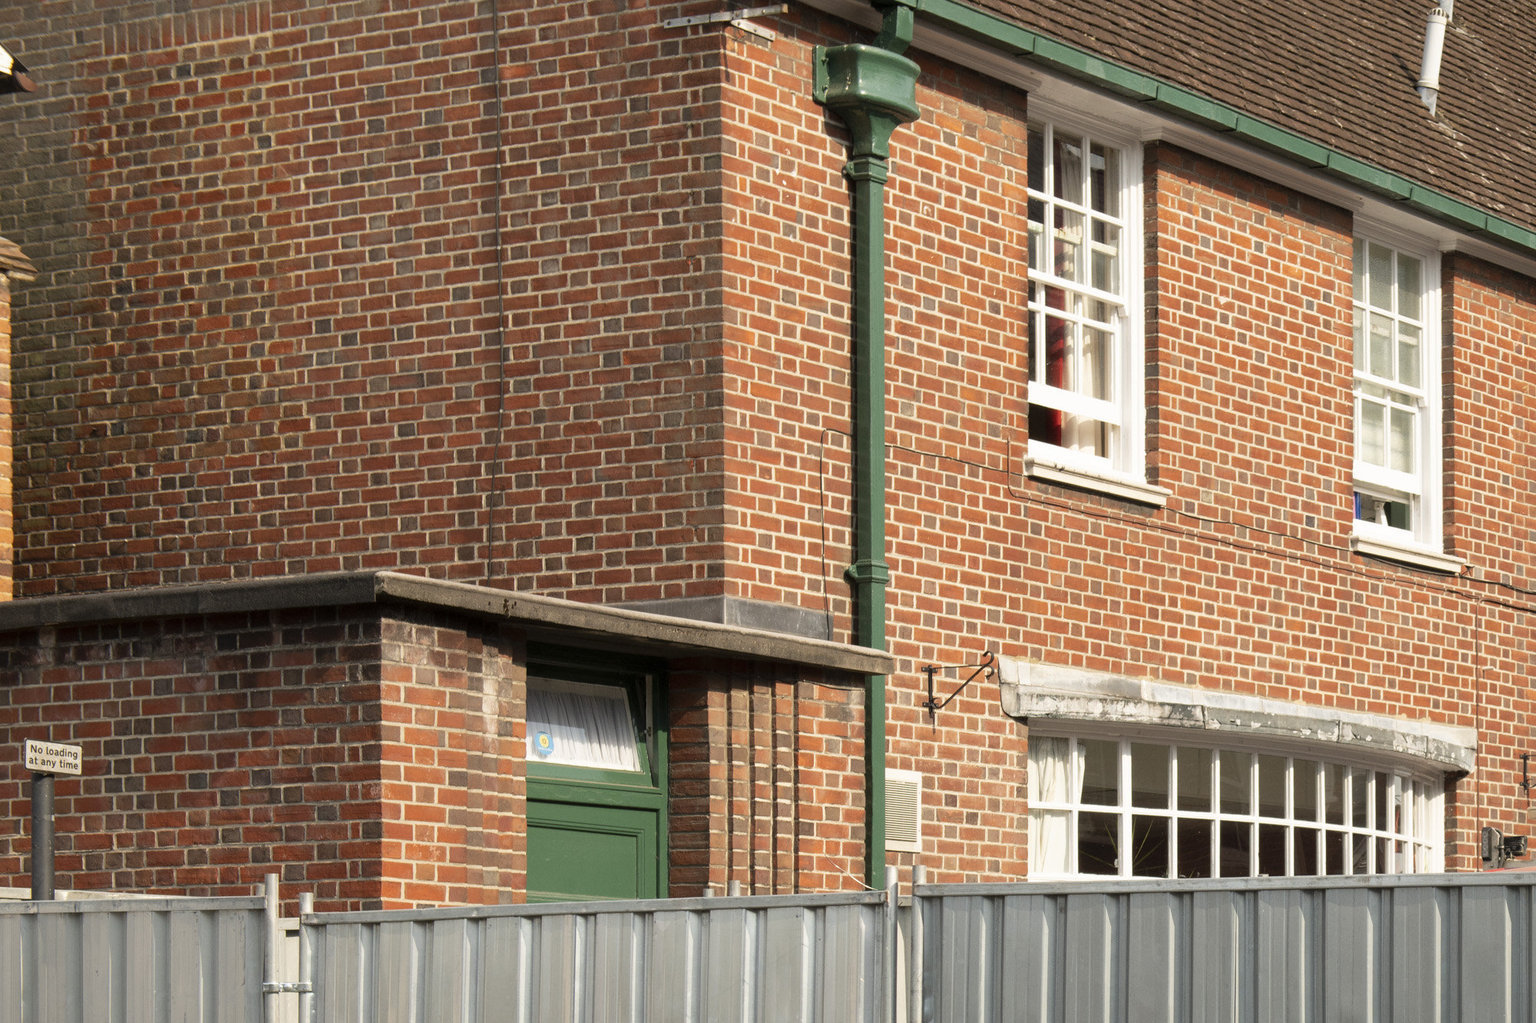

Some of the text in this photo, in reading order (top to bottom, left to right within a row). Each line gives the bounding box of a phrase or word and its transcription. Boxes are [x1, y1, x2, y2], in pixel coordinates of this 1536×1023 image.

[30, 745, 78, 760] No loading
[28, 757, 78, 769] at any time
